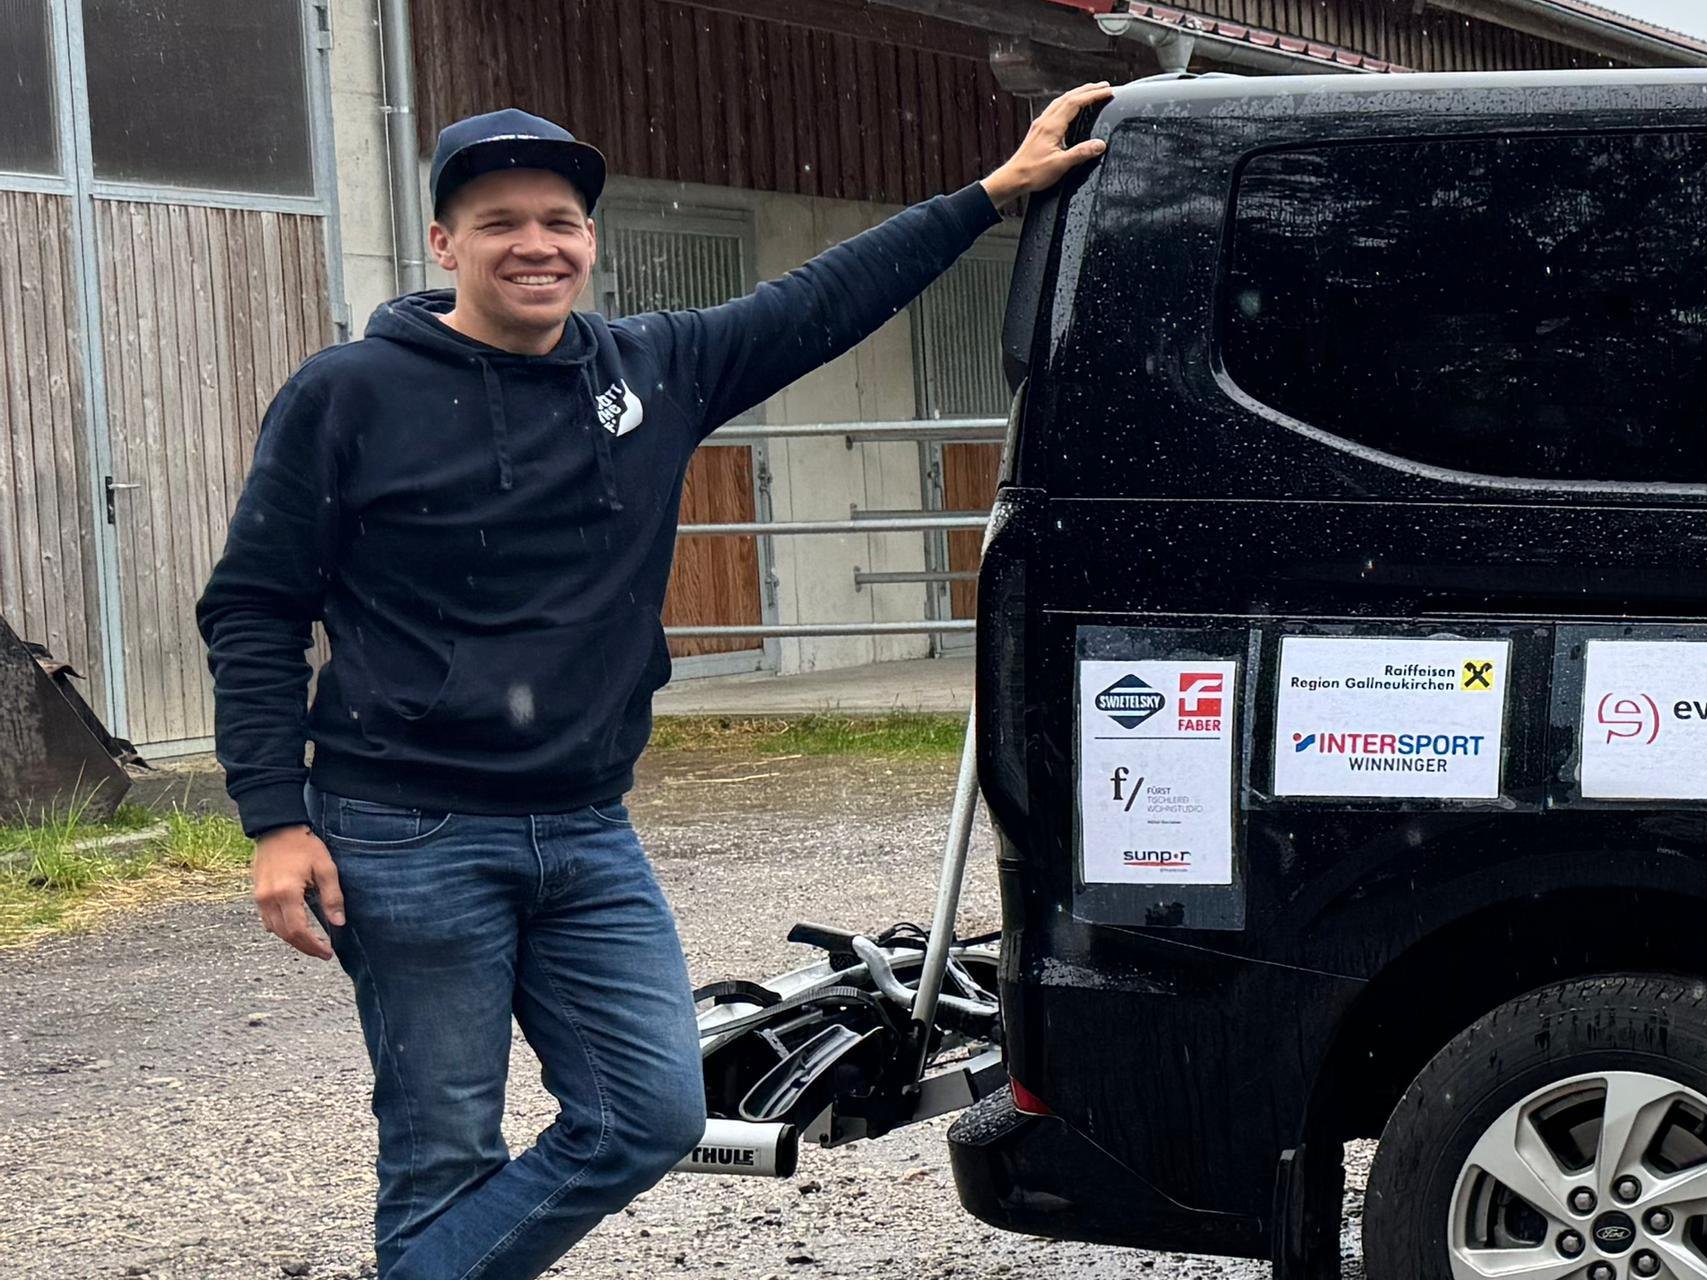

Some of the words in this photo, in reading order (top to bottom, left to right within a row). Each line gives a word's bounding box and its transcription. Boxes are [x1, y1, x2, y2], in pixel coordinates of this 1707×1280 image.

[1384, 664, 1456, 677] Raiffeisen
[1290, 676, 1340, 691] Region
[1345, 677, 1455, 691] Gallneukirchen
[1099, 695, 1161, 709] SWIETELSKY
[1178, 719, 1221, 732] FABER
[1319, 732, 1485, 756] INTERSPORT
[1349, 757, 1448, 772] WINNINGER
[1147, 786, 1171, 795] FÜRST
[692, 1146, 754, 1166] THULE
